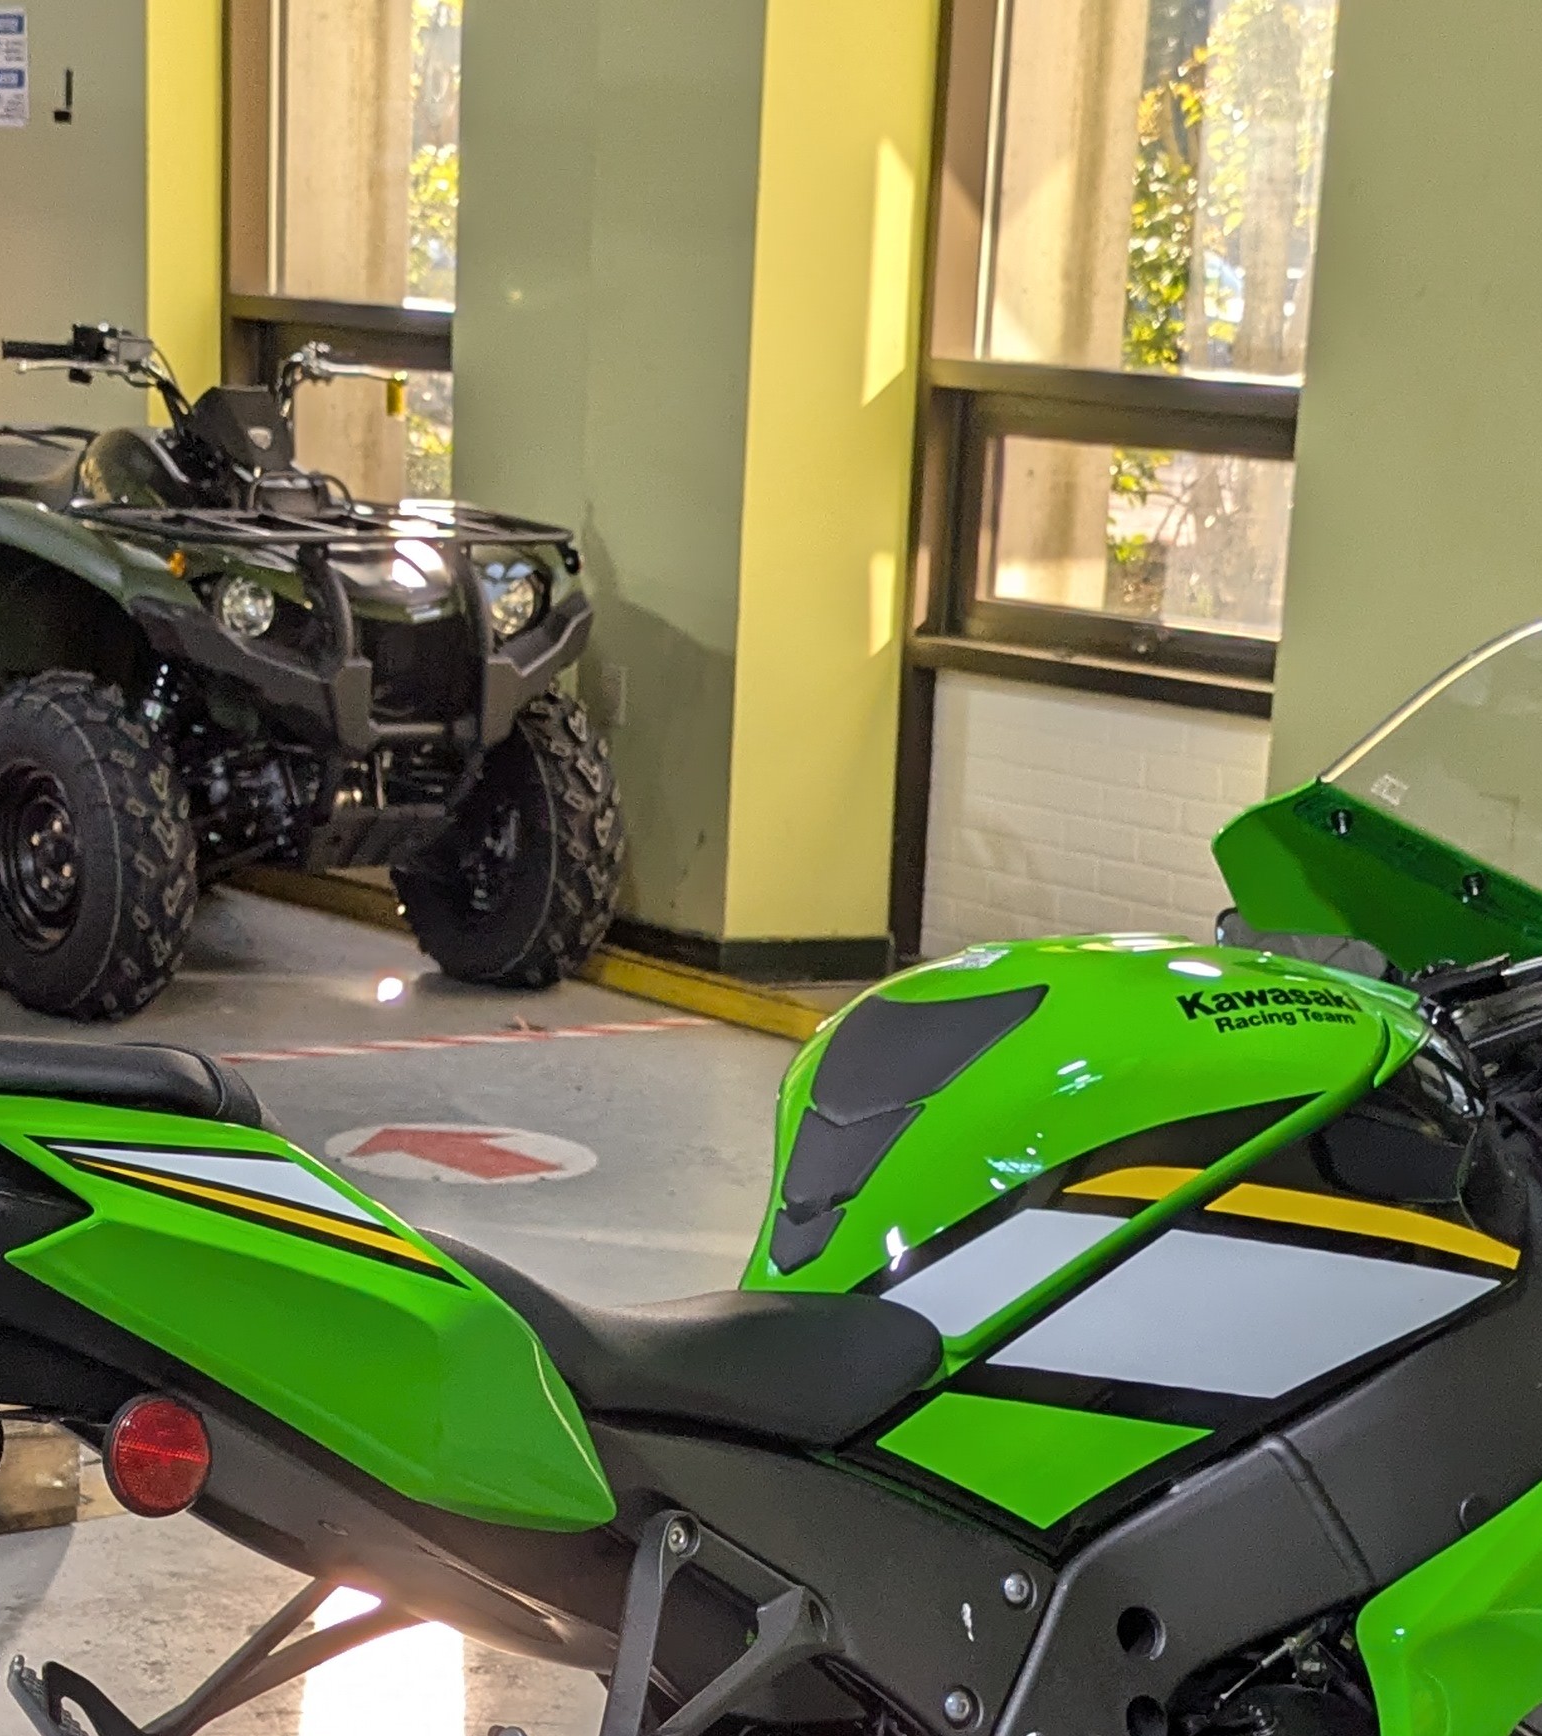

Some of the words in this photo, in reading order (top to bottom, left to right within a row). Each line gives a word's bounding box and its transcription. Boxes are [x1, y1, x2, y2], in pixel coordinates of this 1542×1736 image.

[1177, 988, 1363, 1021] Kawasaki
[1214, 1010, 1298, 1034] Racing
[1296, 1007, 1356, 1025] Team
